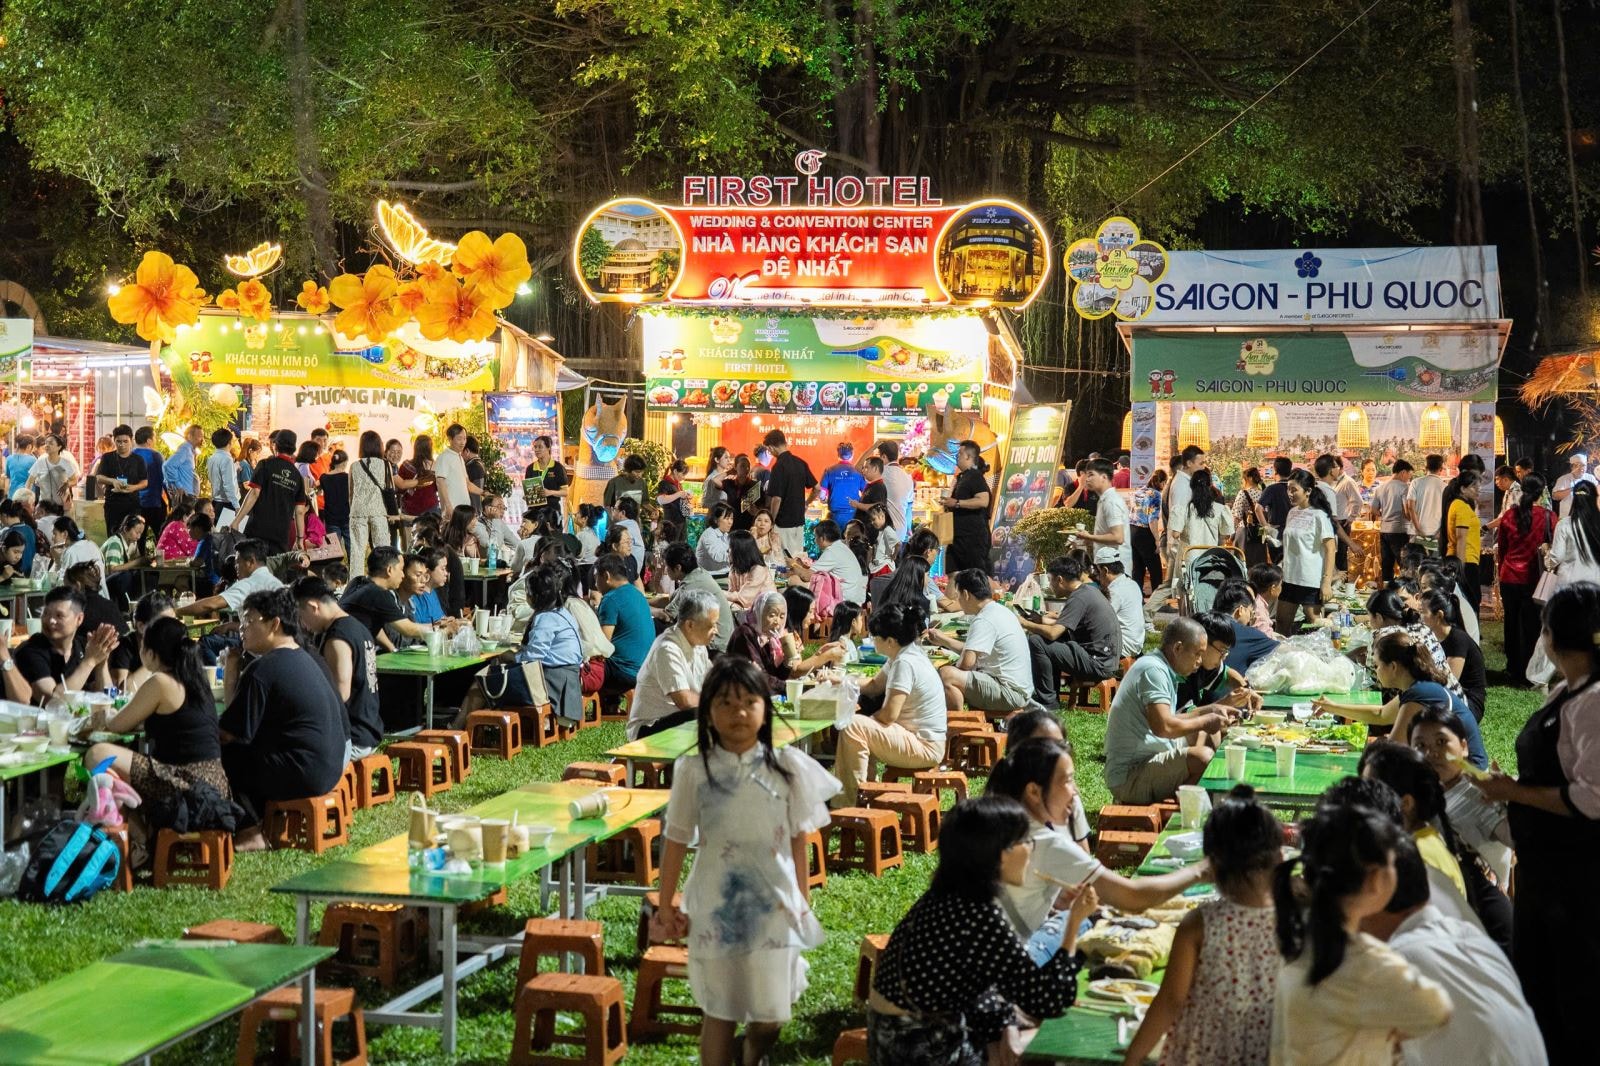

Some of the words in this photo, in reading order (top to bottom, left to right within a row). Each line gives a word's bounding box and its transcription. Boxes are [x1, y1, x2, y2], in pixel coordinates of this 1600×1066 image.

[683, 175, 798, 207] FIRST
[807, 175, 943, 207] HOTEL
[689, 215, 756, 229] WEDDING
[760, 215, 771, 229] &
[773, 215, 869, 229] CONVENTION
[874, 215, 933, 229] CENTER
[692, 232, 735, 253] NHÀ
[742, 232, 800, 253] HÀNG
[806, 230, 878, 253] KHÁCH
[885, 236, 928, 256] SẠN
[762, 258, 790, 277] ĐỆ
[797, 253, 853, 276] NHẤT
[1155, 282, 1278, 311] SAIGON
[1306, 281, 1373, 309] PHU
[1383, 279, 1483, 311] QUOC
[225, 351, 257, 366] KHÁCH
[260, 354, 281, 368] SẠN
[282, 355, 302, 367] KIM
[303, 355, 319, 368] ĐÔ
[699, 347, 738, 358] KHÁCH
[740, 348, 763, 360] SẠN
[765, 347, 781, 361] ĐỆ
[783, 346, 815, 360] NHẤT
[236, 368, 257, 377] ROYAL
[258, 369, 280, 378] HOTEL
[281, 370, 308, 379] SAIGON
[725, 363, 753, 373] FIRST
[754, 363, 787, 374] HOTEL
[1196, 380, 1253, 393] SAIGON
[1266, 380, 1297, 393] PHU
[1302, 380, 1348, 394] QUOC
[295, 387, 369, 408] PHƯƠNG
[372, 389, 416, 410] NAM
[1010, 444, 1036, 467] THỰC
[1036, 443, 1057, 463] ĐƠN
